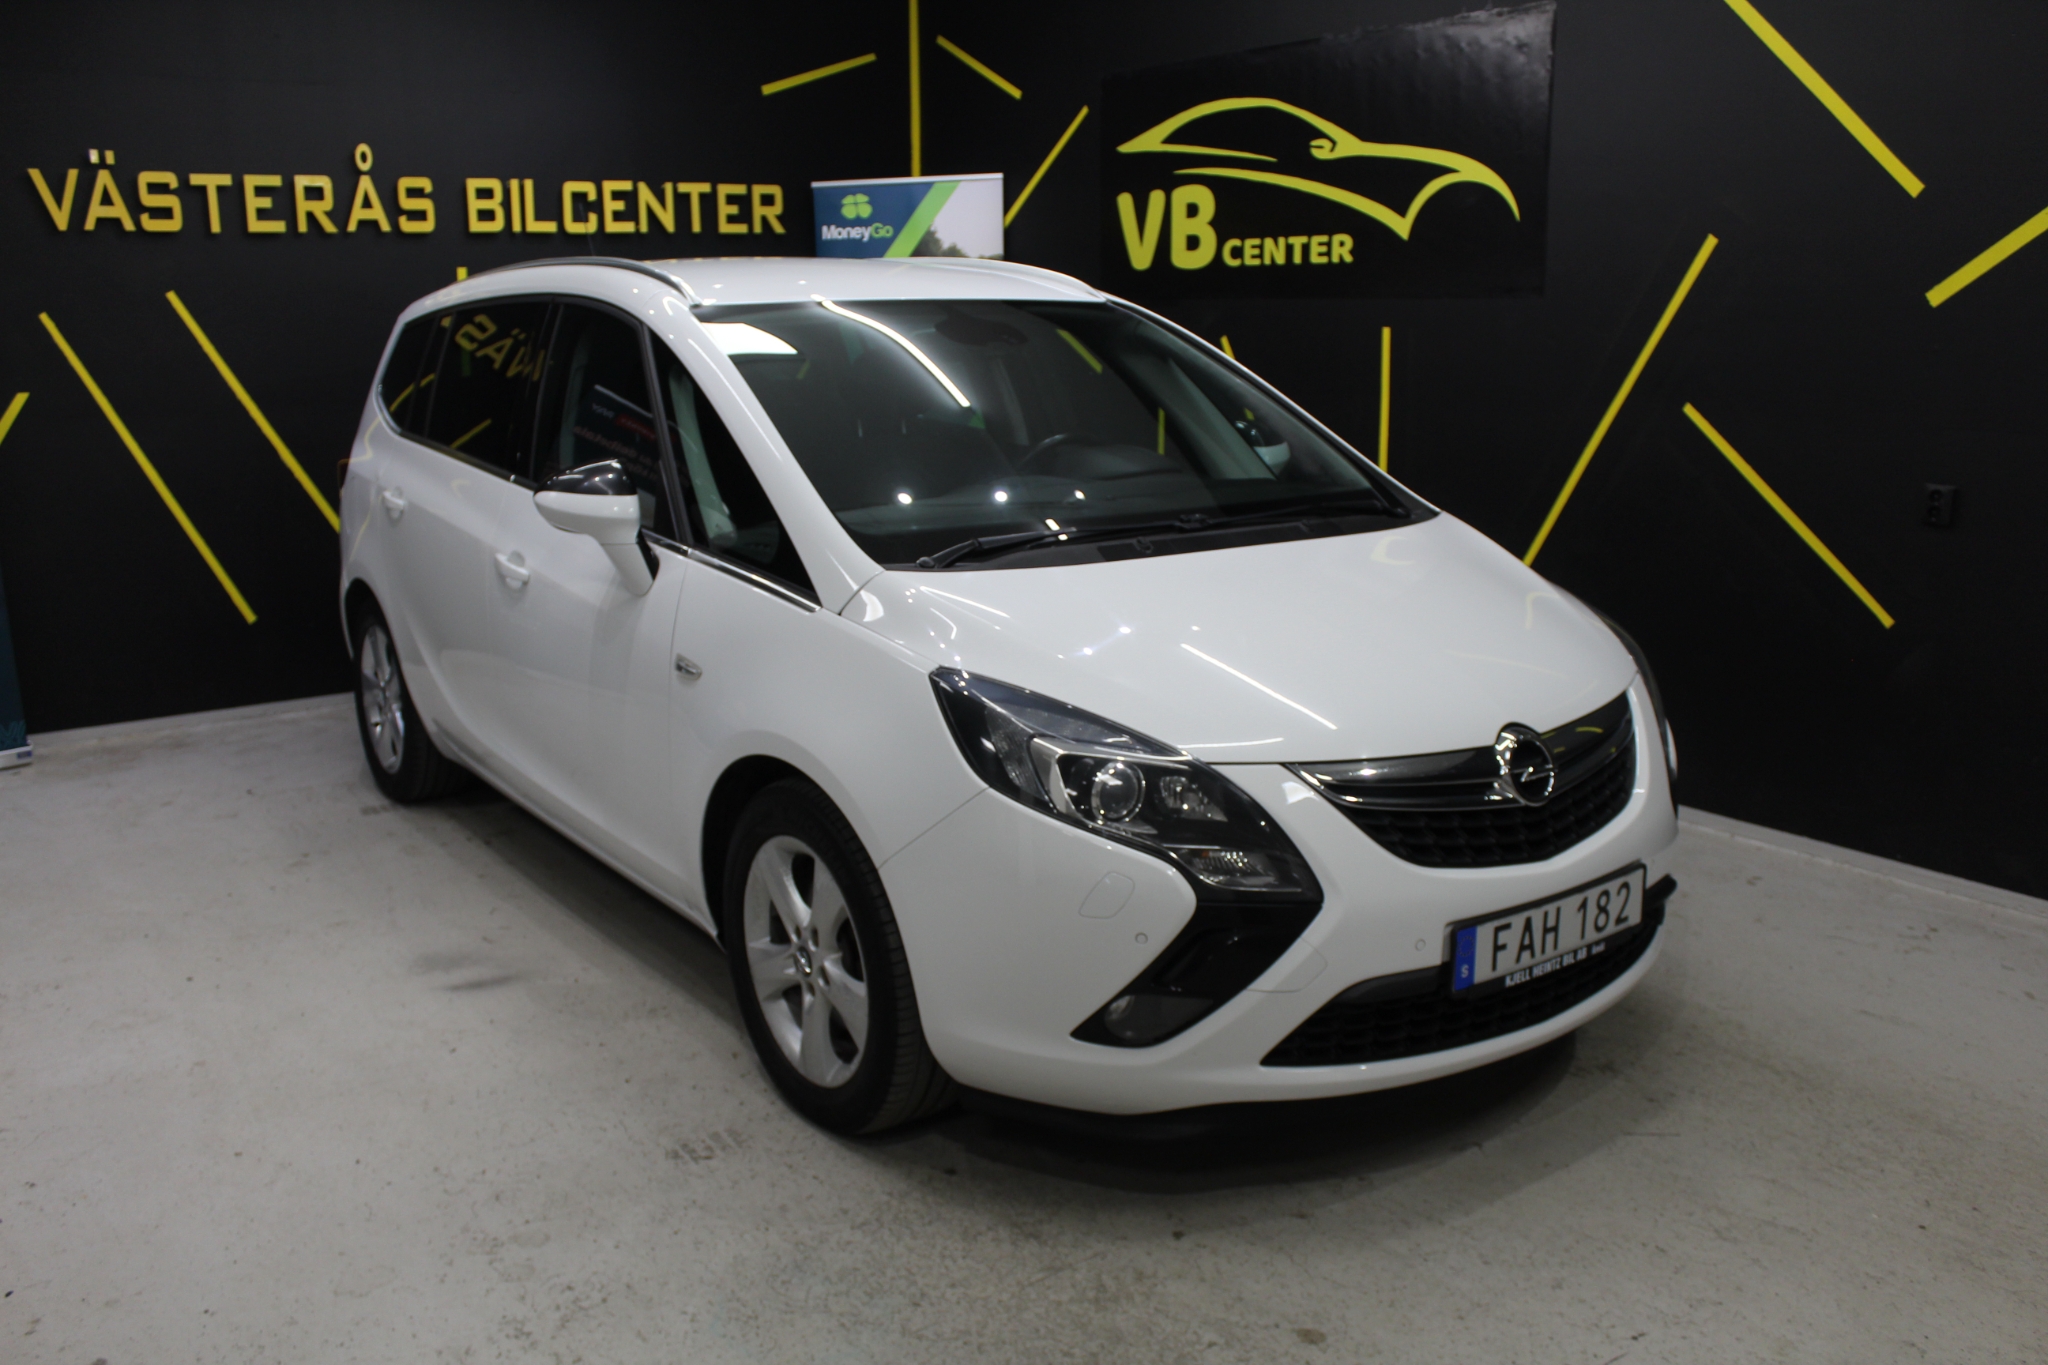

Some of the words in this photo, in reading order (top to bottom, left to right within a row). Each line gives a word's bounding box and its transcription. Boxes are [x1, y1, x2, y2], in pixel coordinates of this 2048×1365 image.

[28, 143, 436, 233] VÄSTERÅS
[466, 177, 786, 234] BILCENTER
[1116, 184, 1217, 271] VB
[1222, 233, 1354, 267] CENTER
[822, 223, 894, 242] MoneyGo
[1492, 907, 1561, 972] FAH
[1577, 881, 1631, 940] 182
[1461, 964, 1469, 978] S
